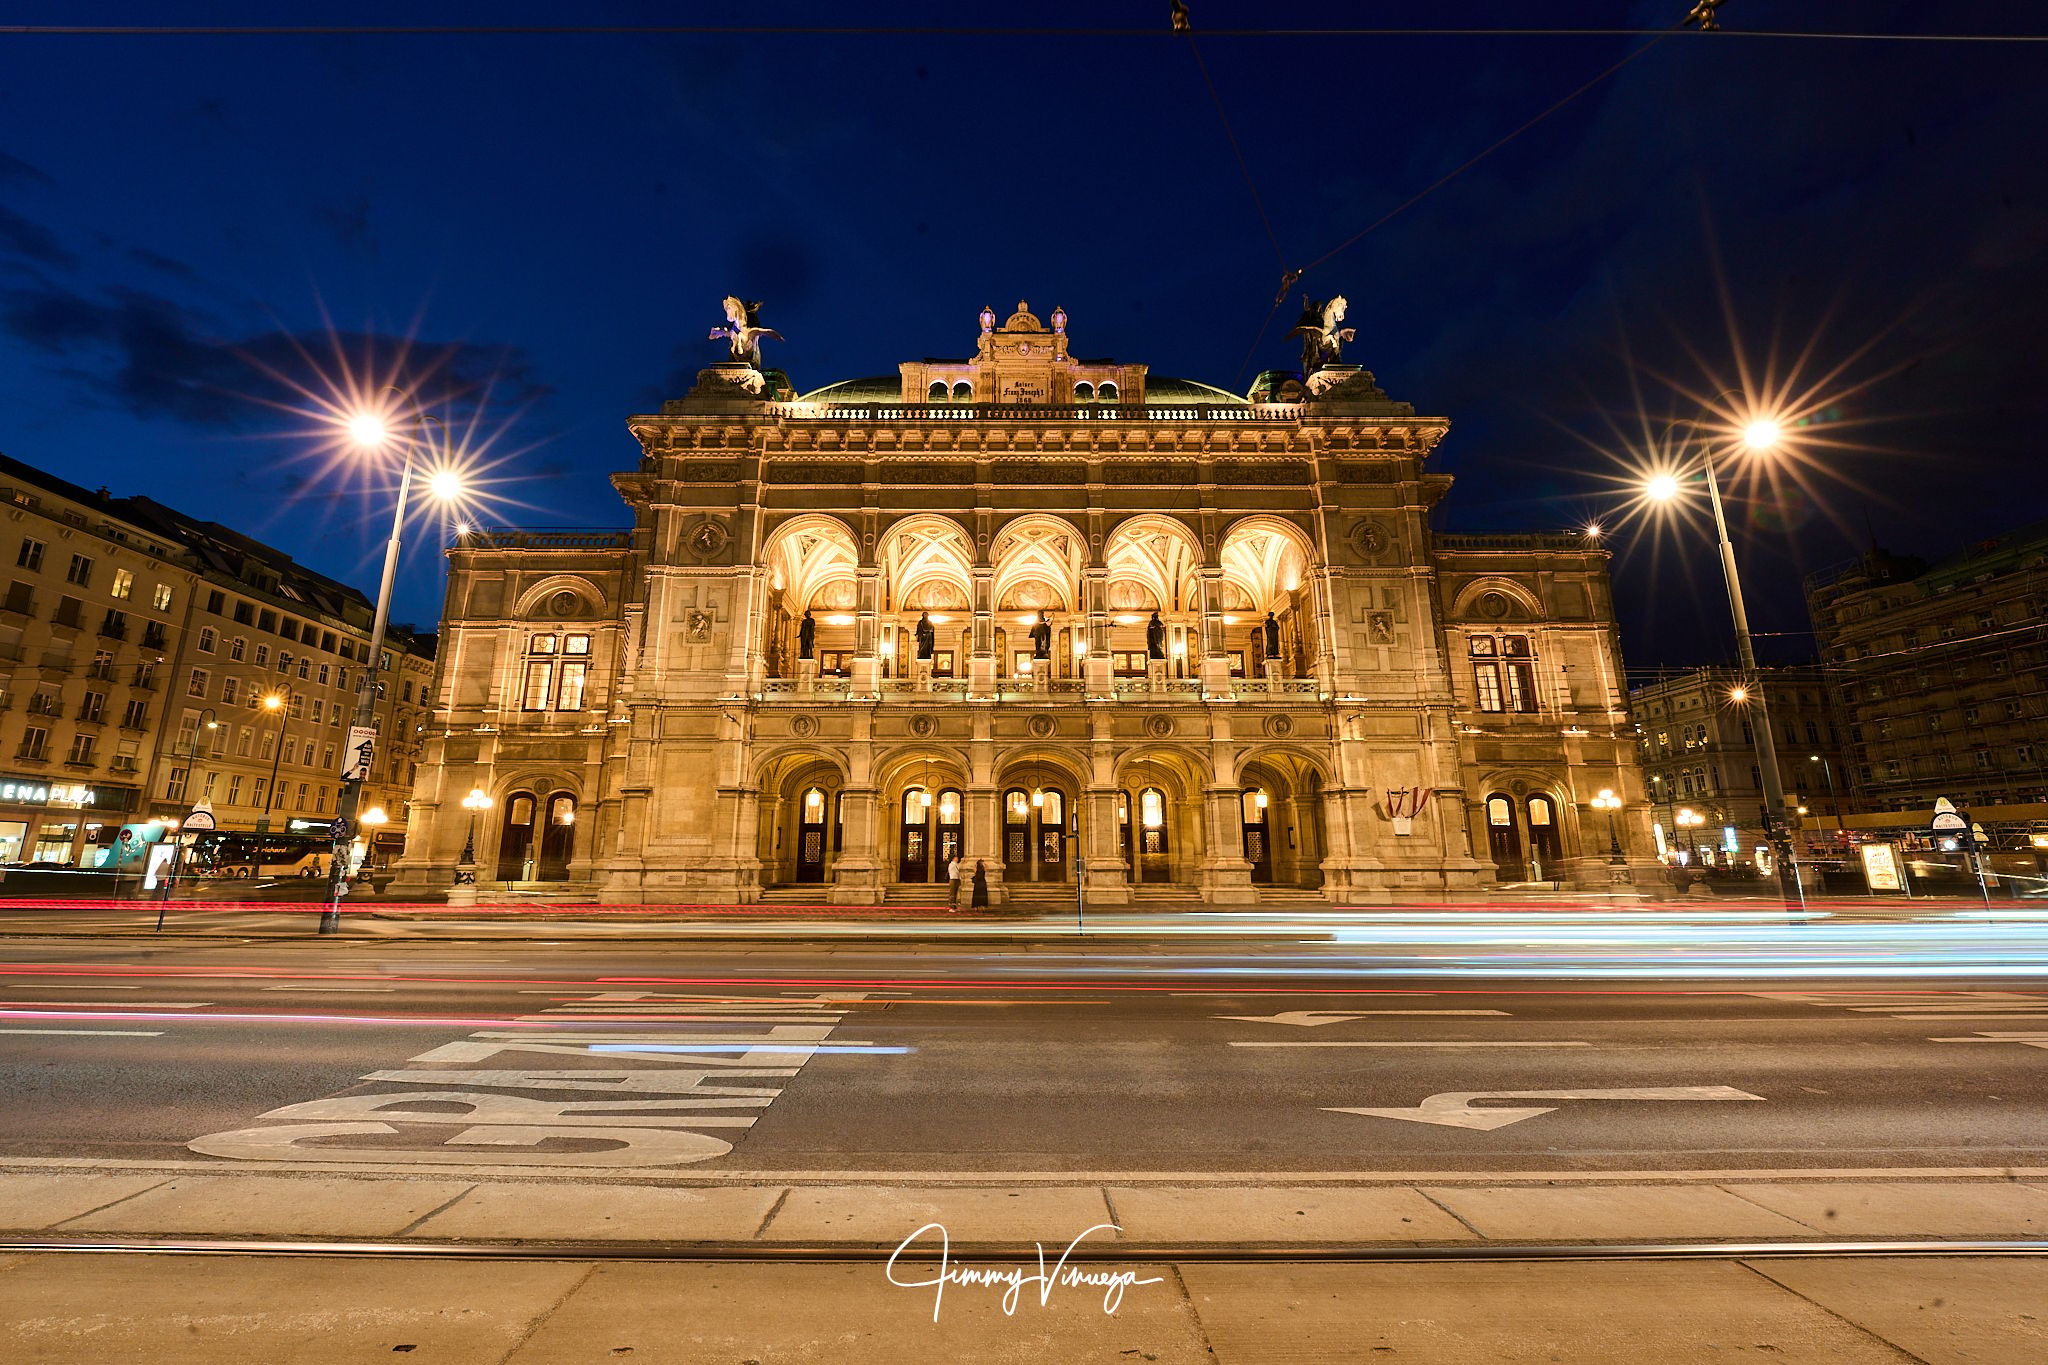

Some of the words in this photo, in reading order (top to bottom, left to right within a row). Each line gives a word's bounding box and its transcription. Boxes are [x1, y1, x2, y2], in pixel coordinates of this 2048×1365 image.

[1003, 387, 1020, 397] Franz
[0, 784, 46, 801] ENA
[50, 787, 96, 805] PLAZA
[186, 1040, 820, 1167] GRAZ
